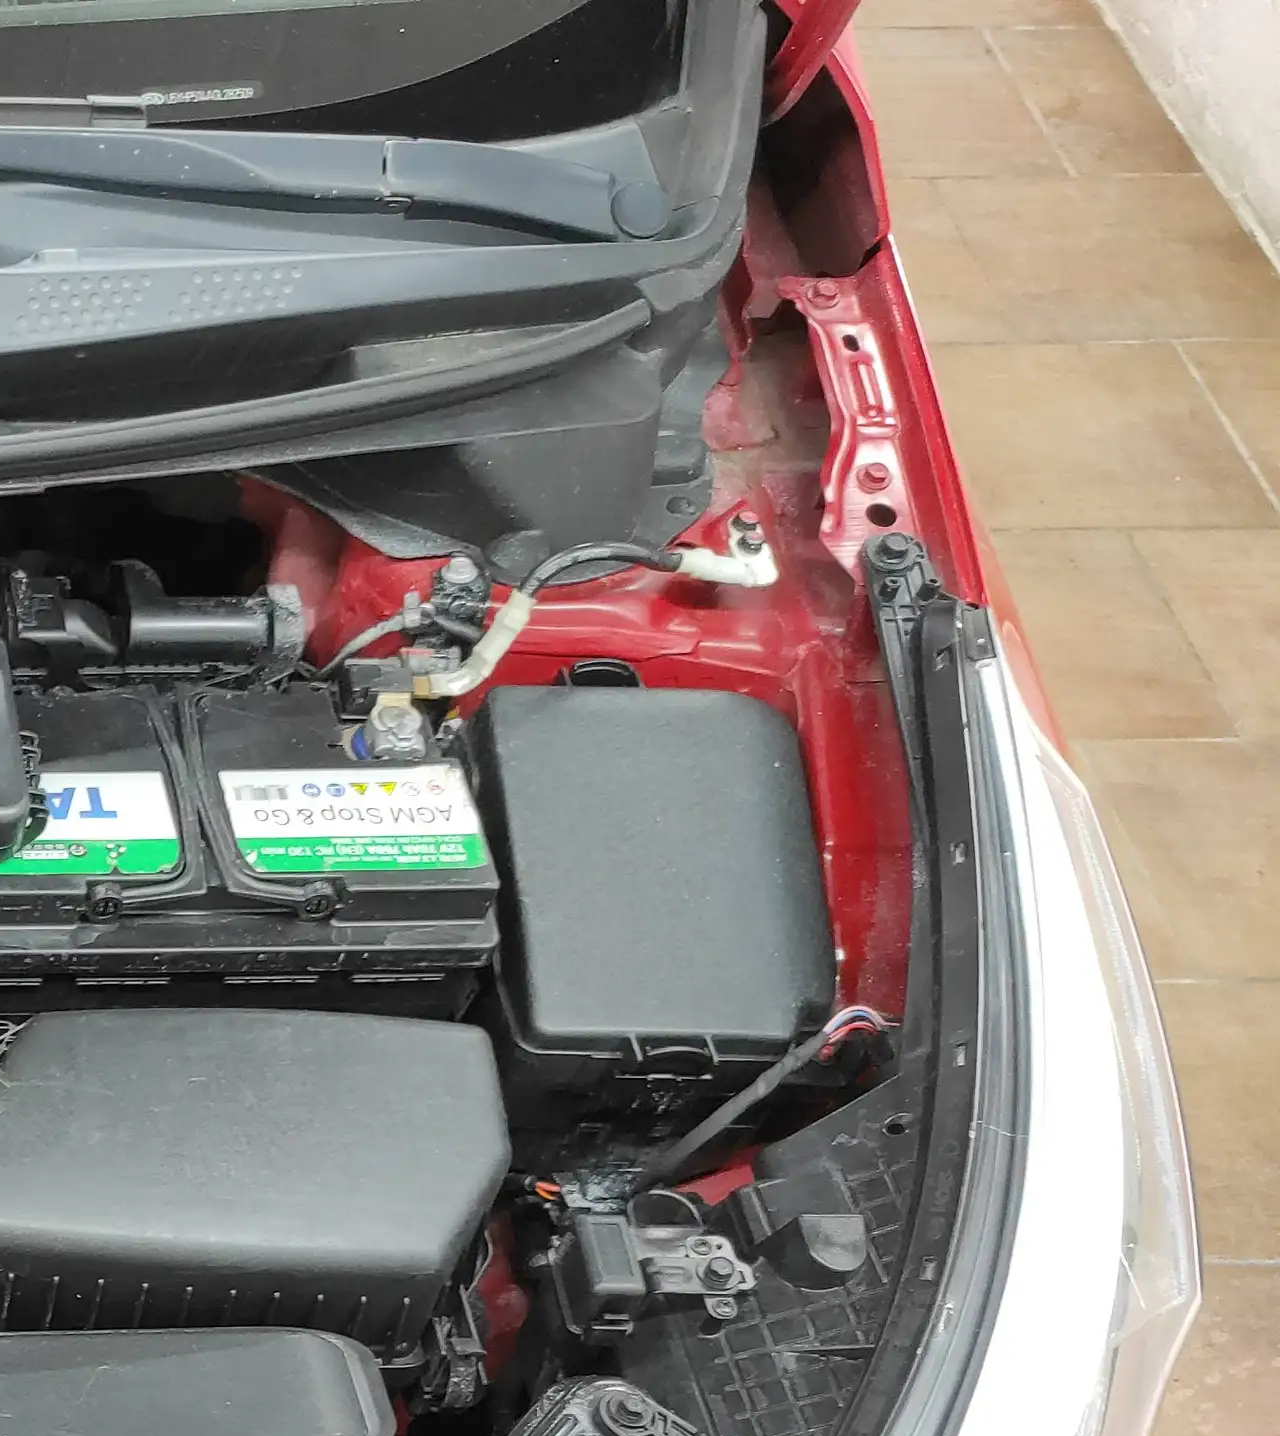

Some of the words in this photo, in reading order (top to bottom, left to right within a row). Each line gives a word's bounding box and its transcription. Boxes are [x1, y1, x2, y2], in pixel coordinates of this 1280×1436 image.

[254, 808, 290, 826] Go
[297, 807, 314, 825] &
[321, 804, 383, 825] Stop
[390, 804, 452, 824] AGM
